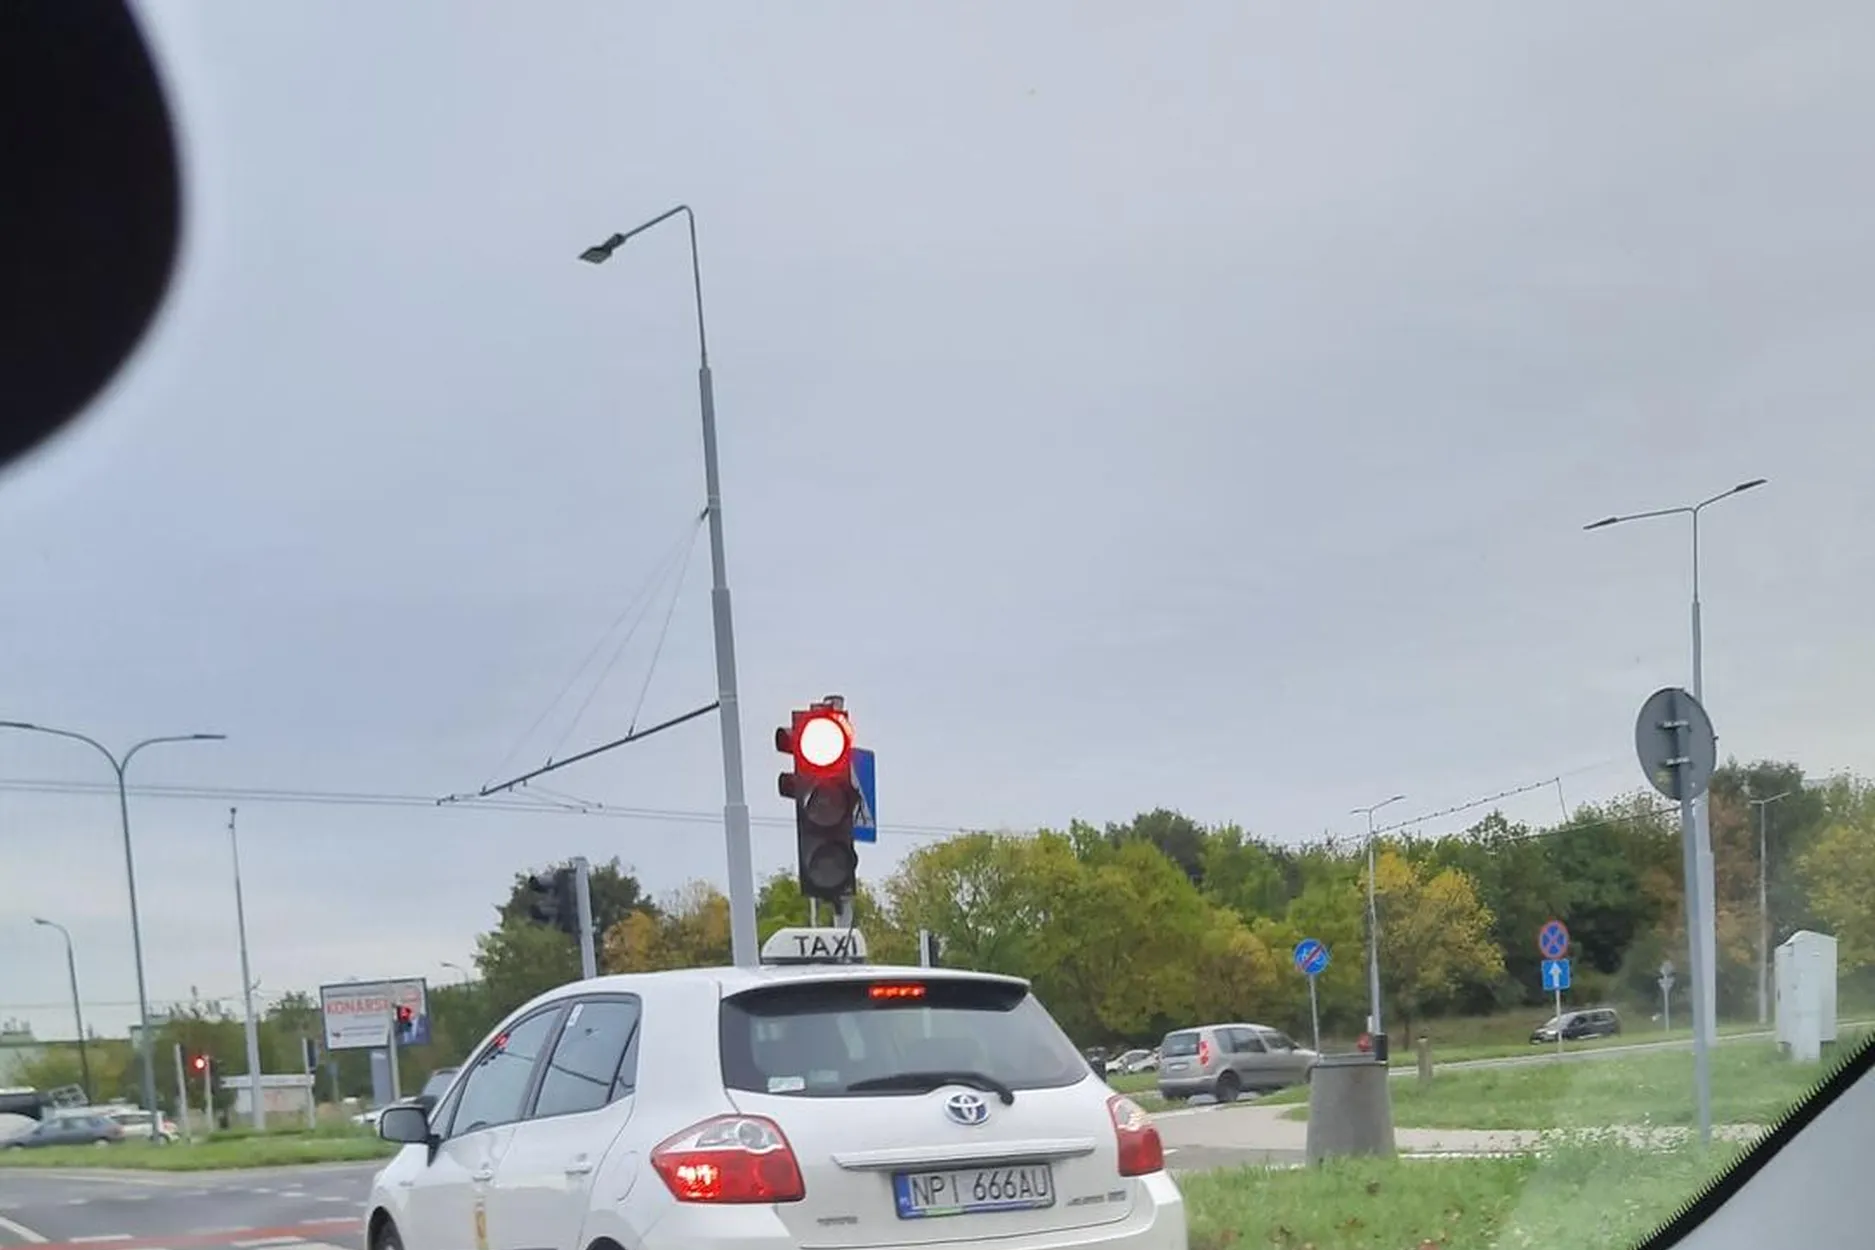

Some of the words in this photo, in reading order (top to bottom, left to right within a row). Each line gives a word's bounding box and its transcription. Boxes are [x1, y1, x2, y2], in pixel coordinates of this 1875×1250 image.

[793, 935, 858, 956] TAXI
[911, 1174, 959, 1206] NPI
[973, 1167, 1049, 1201] 666AU
